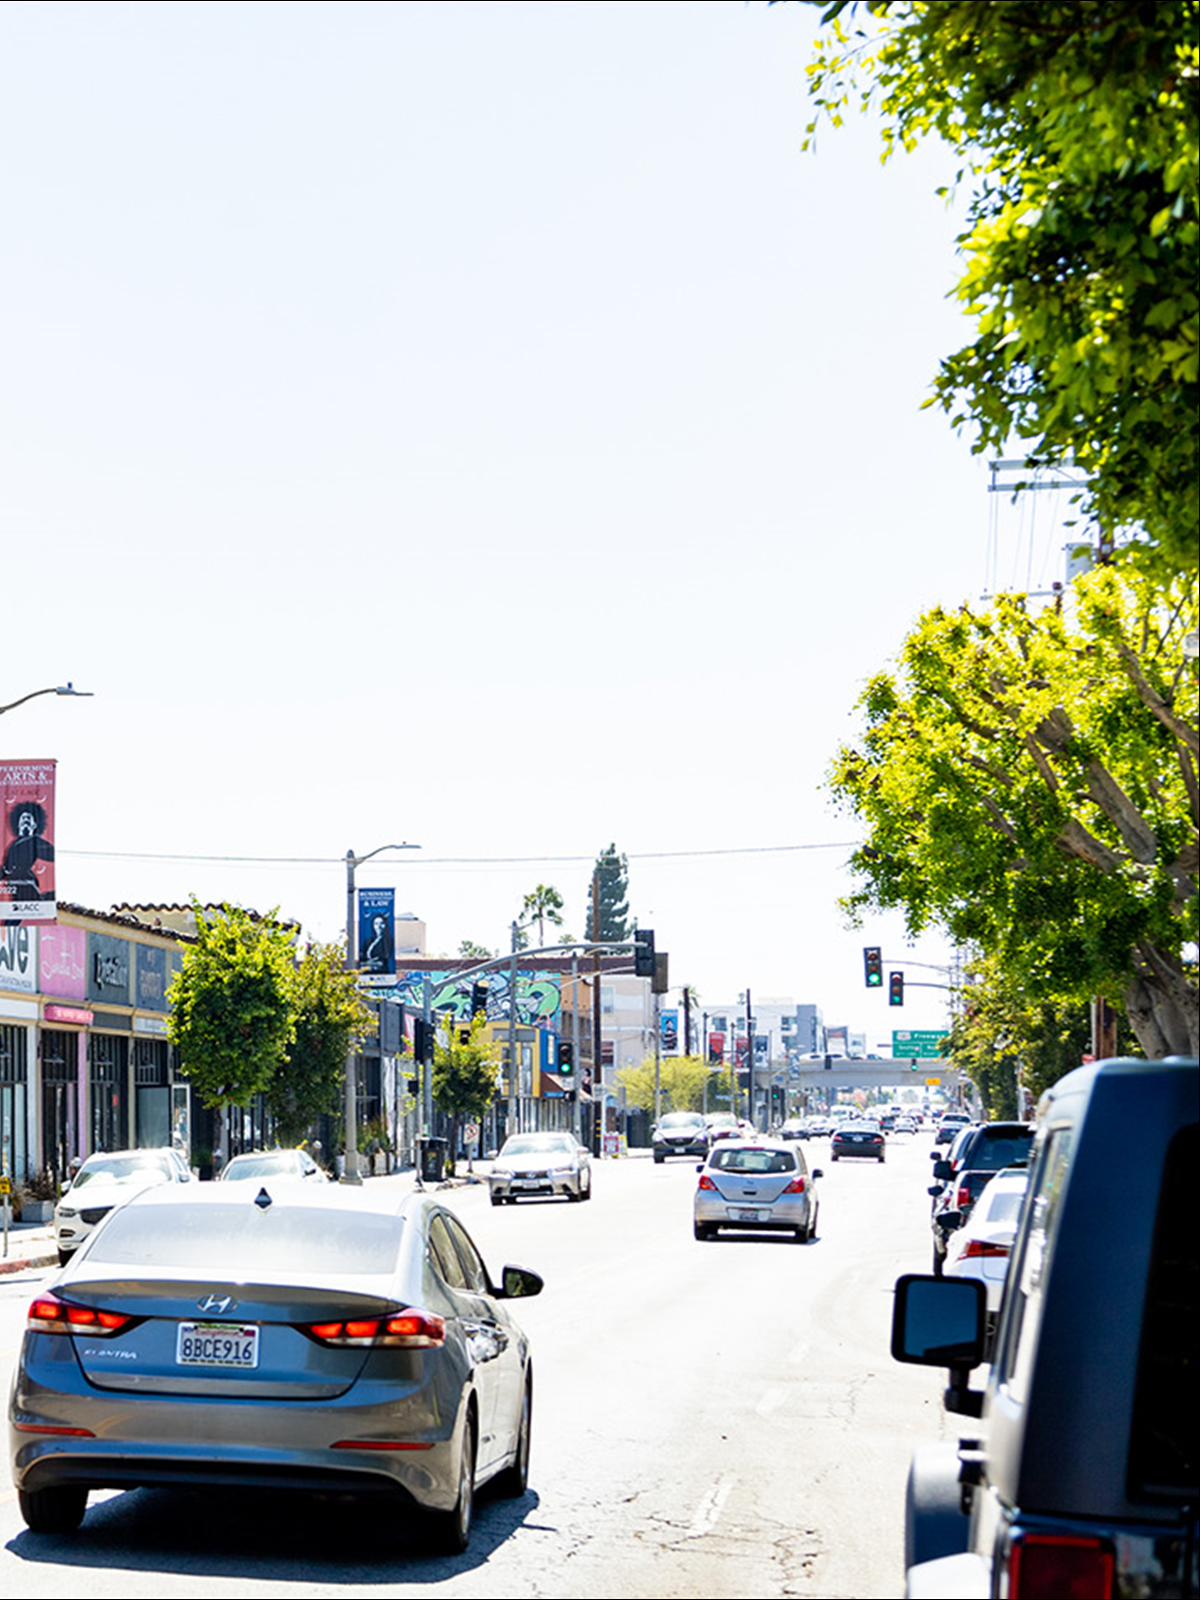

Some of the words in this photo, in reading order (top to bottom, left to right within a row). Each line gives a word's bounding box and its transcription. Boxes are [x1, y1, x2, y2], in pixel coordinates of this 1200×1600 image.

[4, 771, 35, 781] ARTS
[37, 771, 47, 780] &
[18, 903, 39, 912] LACC
[84, 1349, 137, 1360] ELANTRA
[183, 1338, 253, 1361] 8BCE916
